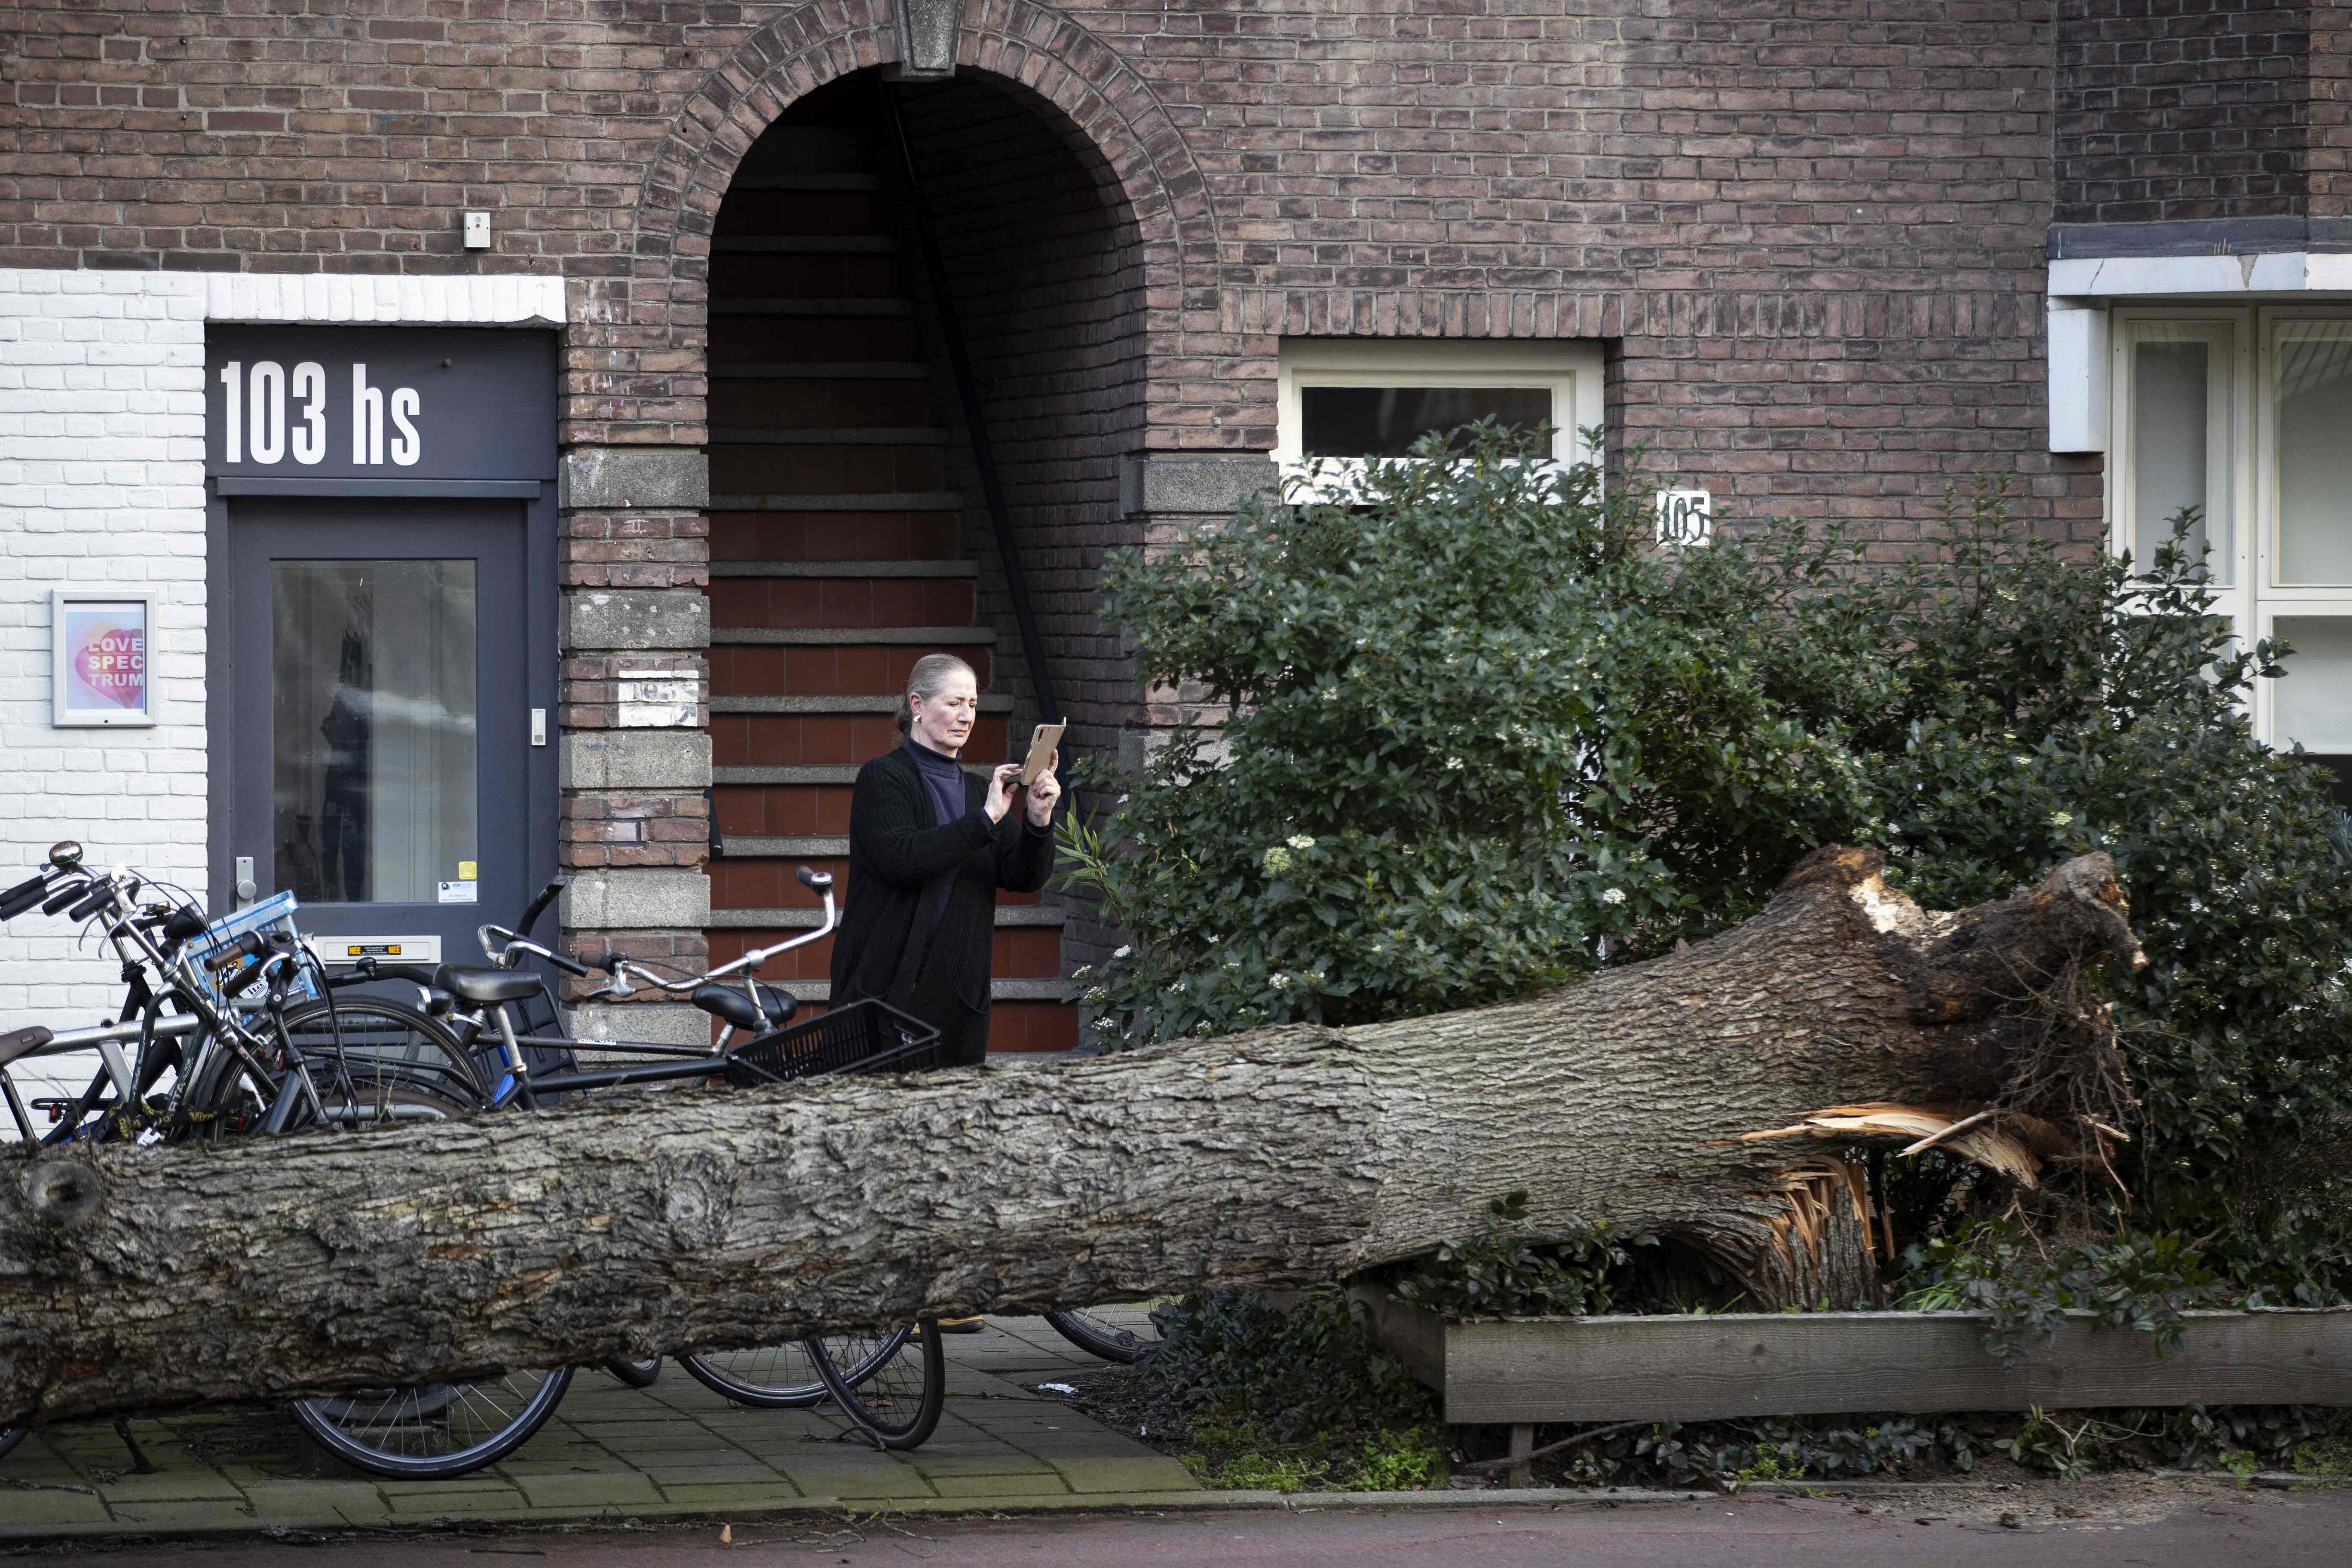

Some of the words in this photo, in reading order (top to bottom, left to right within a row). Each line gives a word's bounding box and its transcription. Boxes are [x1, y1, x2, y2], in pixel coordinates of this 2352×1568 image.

[220, 361, 326, 465] 103
[353, 363, 420, 466] hs
[1662, 496, 1705, 541] 105
[89, 638, 143, 652] LOVE
[88, 655, 143, 670] SPEC
[88, 674, 143, 687] TRUM
[388, 946, 400, 954] NEE
